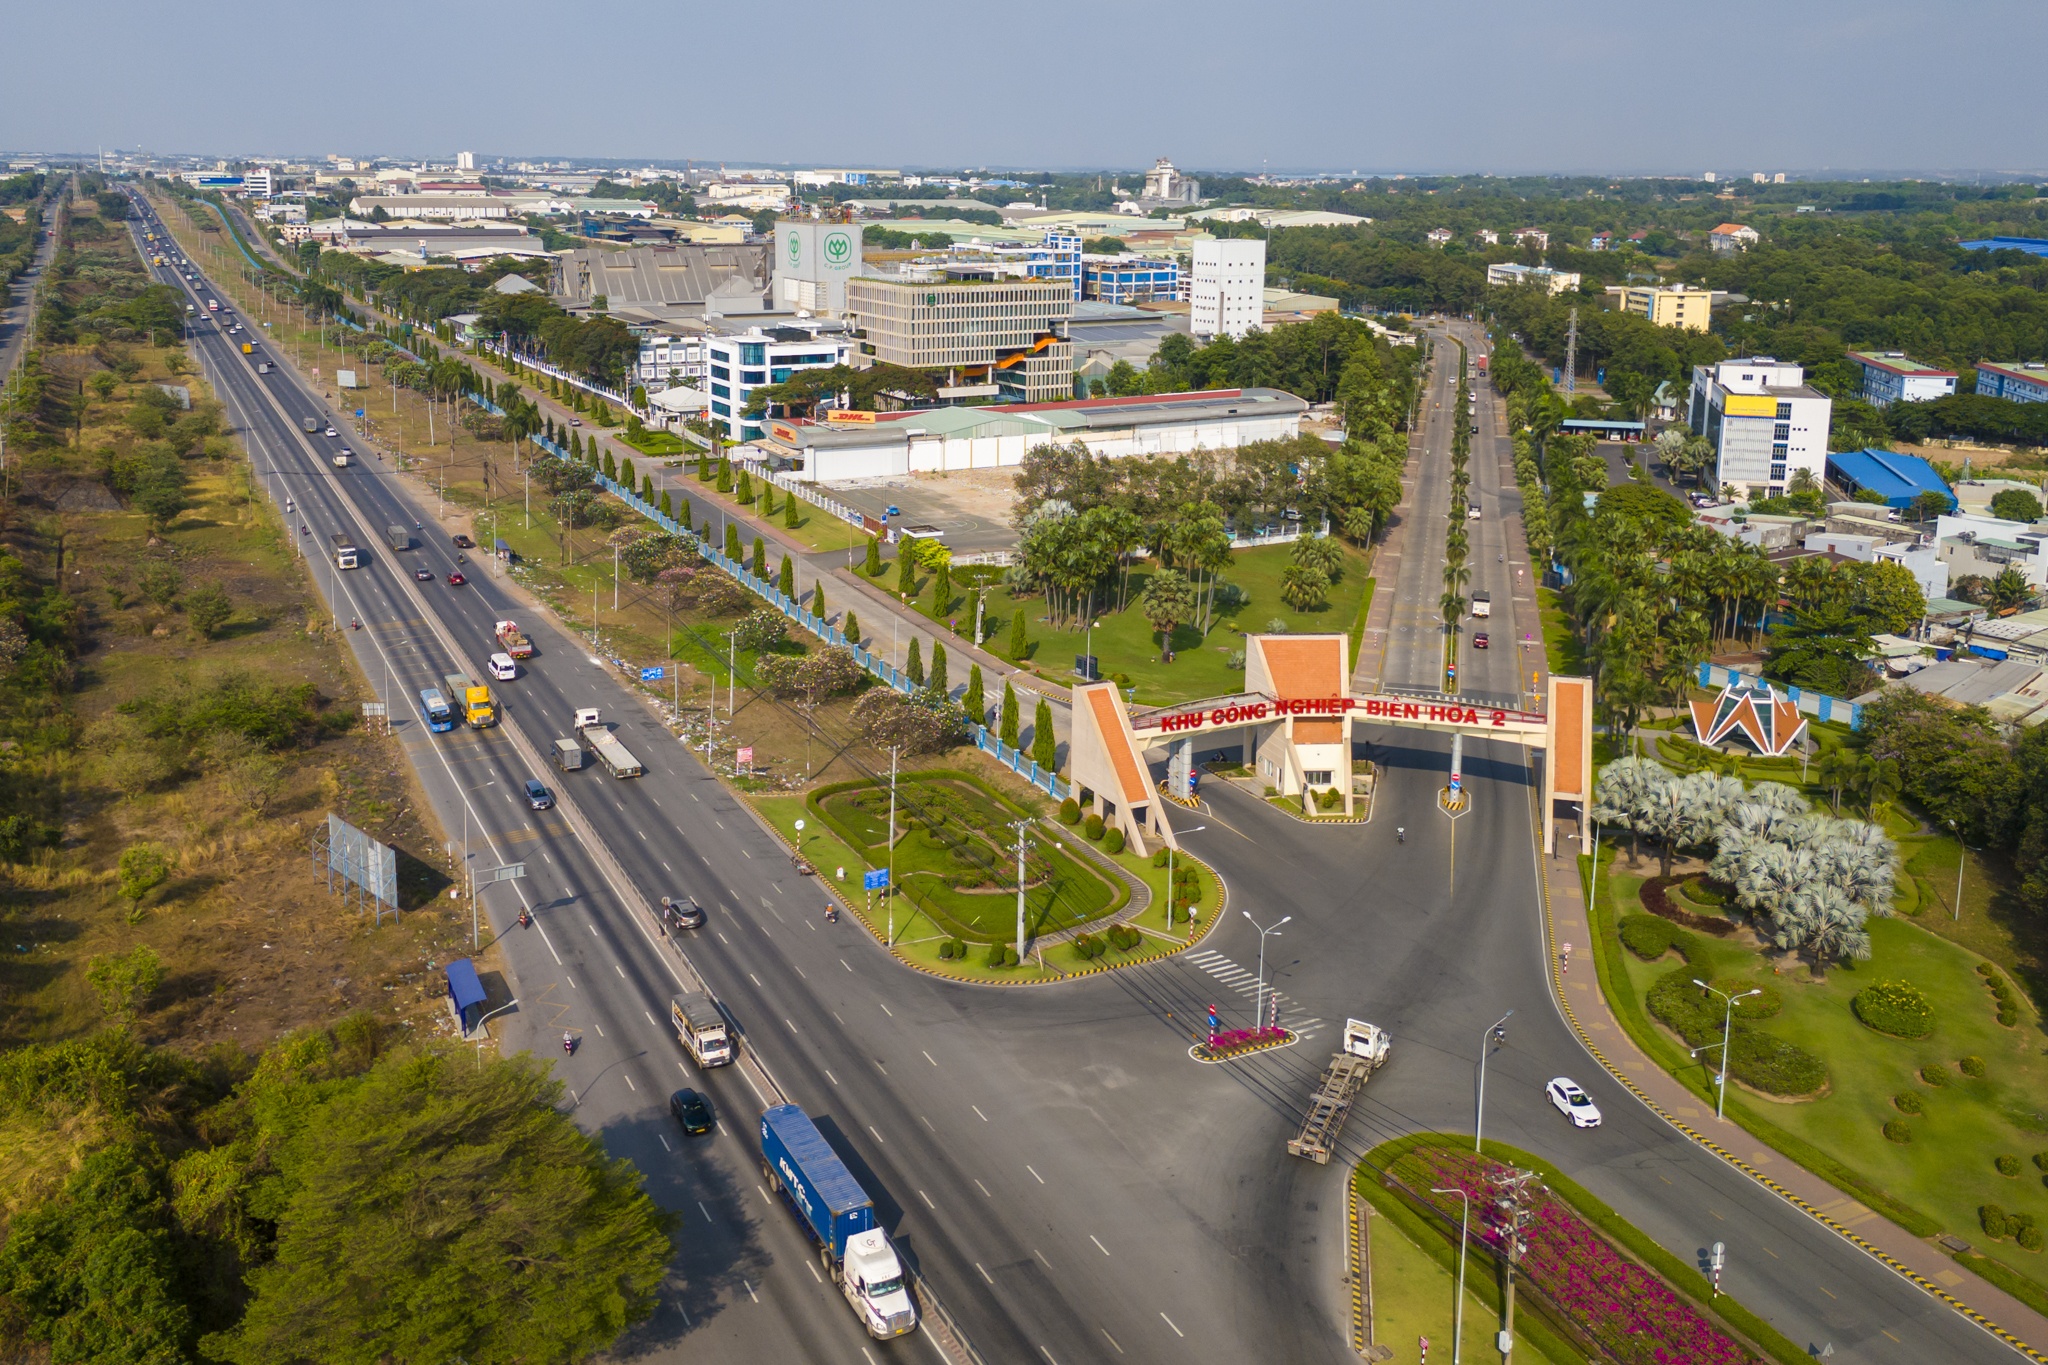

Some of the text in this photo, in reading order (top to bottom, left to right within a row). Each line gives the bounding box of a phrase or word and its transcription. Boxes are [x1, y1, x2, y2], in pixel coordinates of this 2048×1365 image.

[838, 413, 864, 421] DHL
[1161, 693, 1506, 732] KHU CÔNG NGHIỆP BIÊN HÒA 2
